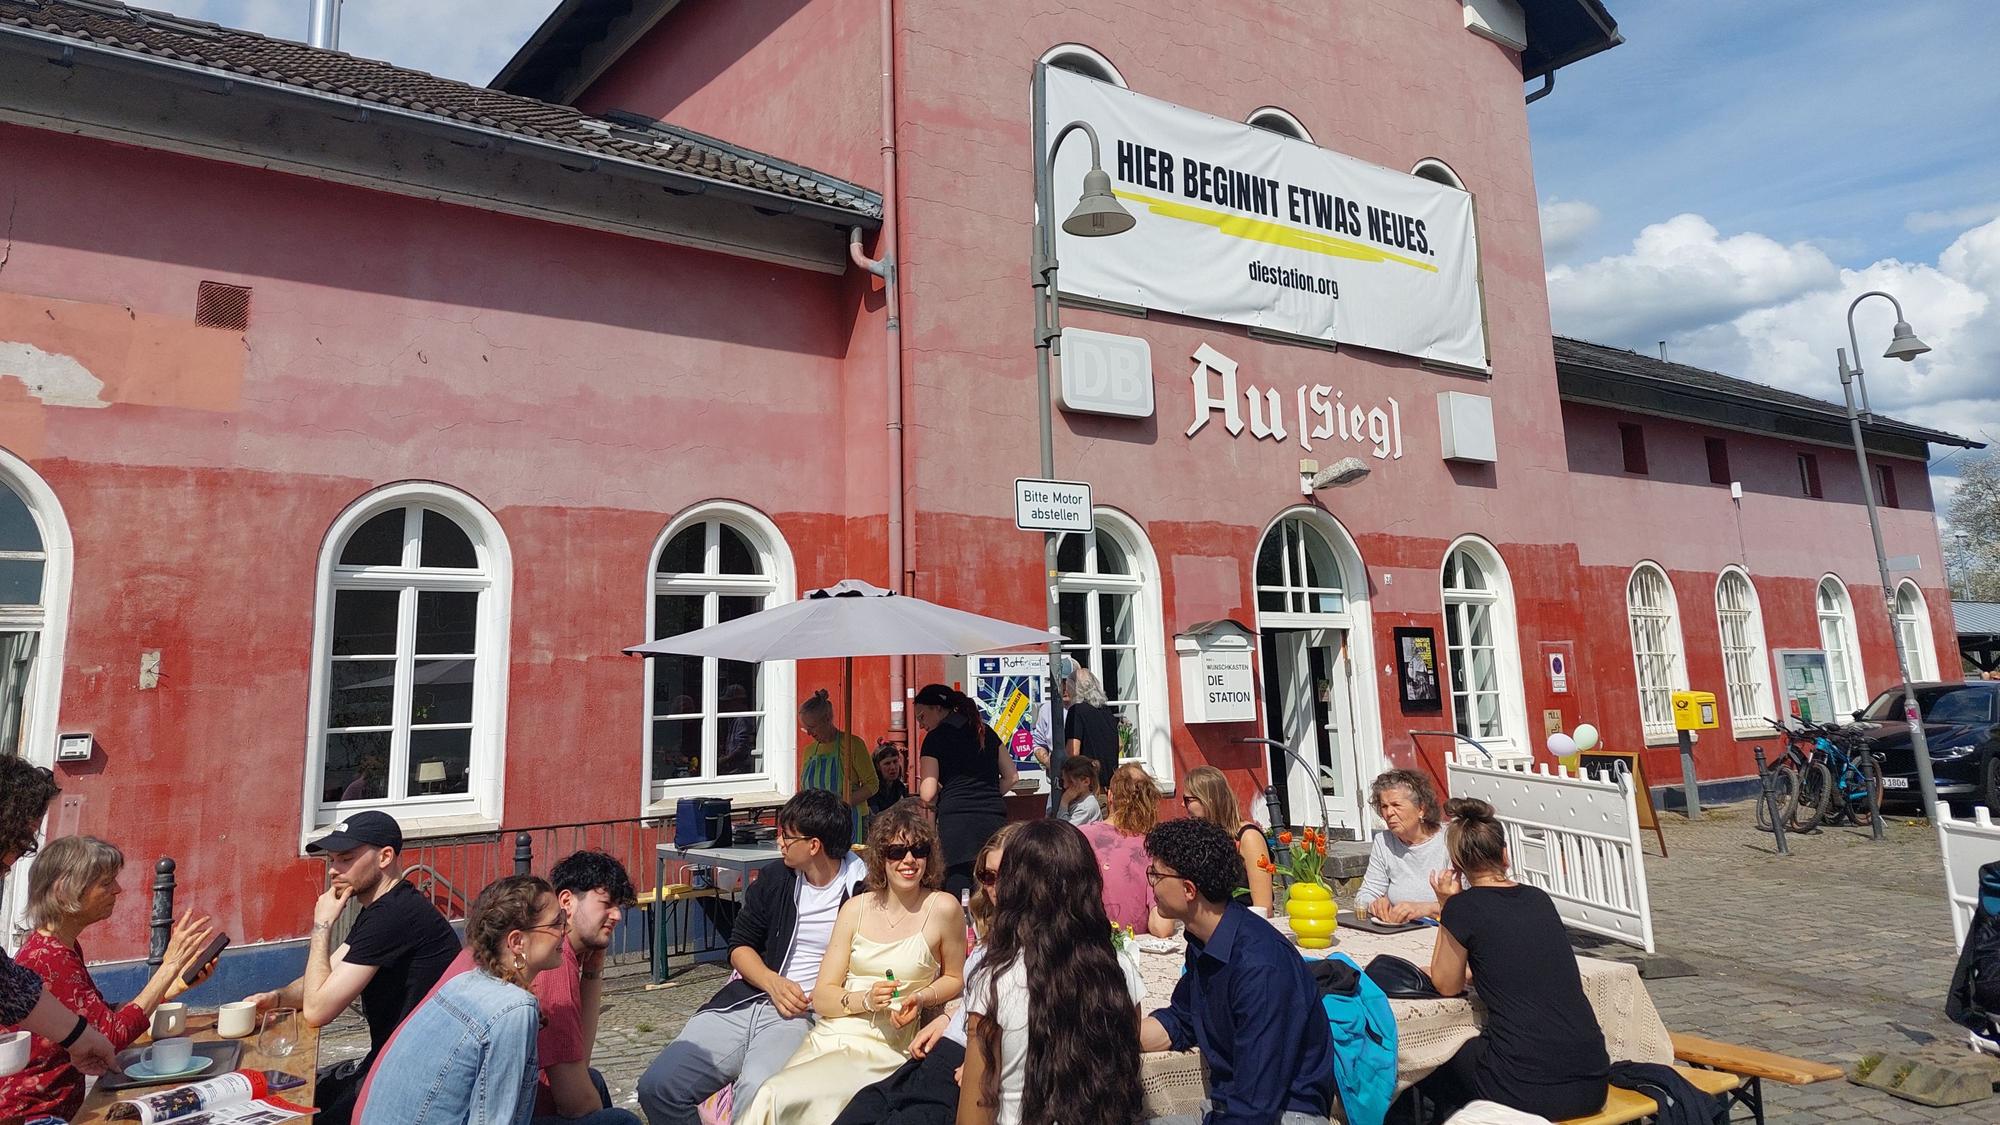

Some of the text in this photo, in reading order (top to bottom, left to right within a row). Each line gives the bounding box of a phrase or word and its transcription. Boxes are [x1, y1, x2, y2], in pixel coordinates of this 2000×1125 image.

[1117, 140, 1435, 256] HIER BEGINNT ETWAS NEUES.
[1248, 260, 1339, 300] diestation.org
[1074, 340, 1144, 402] DB
[1186, 342, 1287, 441] Au
[1024, 490, 1083, 505] Bitte Motor
[1031, 507, 1080, 521] abstellen
[1206, 663, 1249, 671] WUNSCHKASTEN
[1208, 675, 1224, 686] DIE
[1209, 691, 1251, 704] STATION
[1016, 744, 1031, 753] VISA
